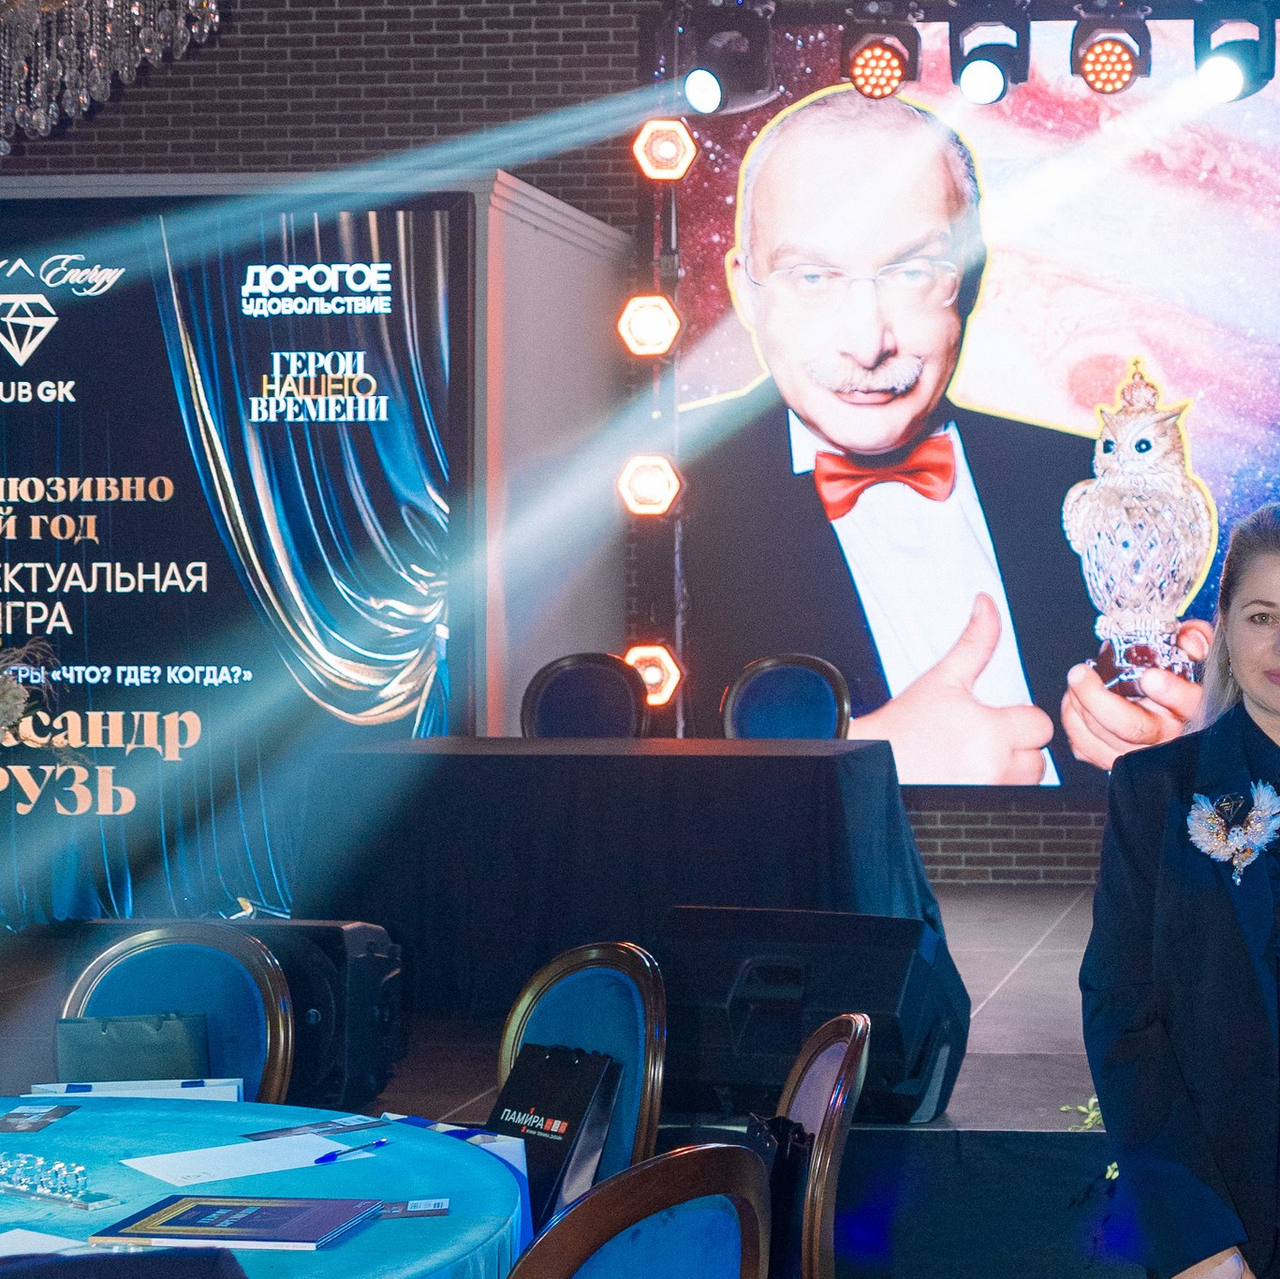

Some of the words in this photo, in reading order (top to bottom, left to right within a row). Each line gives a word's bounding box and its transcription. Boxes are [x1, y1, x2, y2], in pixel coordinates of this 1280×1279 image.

[39, 253, 126, 297] Energy
[240, 262, 393, 297] ДОРОГОЕ
[241, 296, 393, 318] УДОВОЛЬСТВИЕ
[270, 350, 367, 378] ГЕРОИ
[36, 380, 77, 404] GK
[262, 373, 378, 399] НАШЕГО
[248, 395, 390, 423] ВРЕМЕНИ
[0, 561, 208, 593] КТУАЛЬНАЯ
[0, 601, 74, 635] ГРА
[51, 665, 113, 684] «ЧТО?
[116, 665, 160, 687] ГДЕ?
[166, 665, 254, 687] КОГДА?»
[1, 710, 202, 762] сандр
[500, 1108, 546, 1129] ПАМИРА
